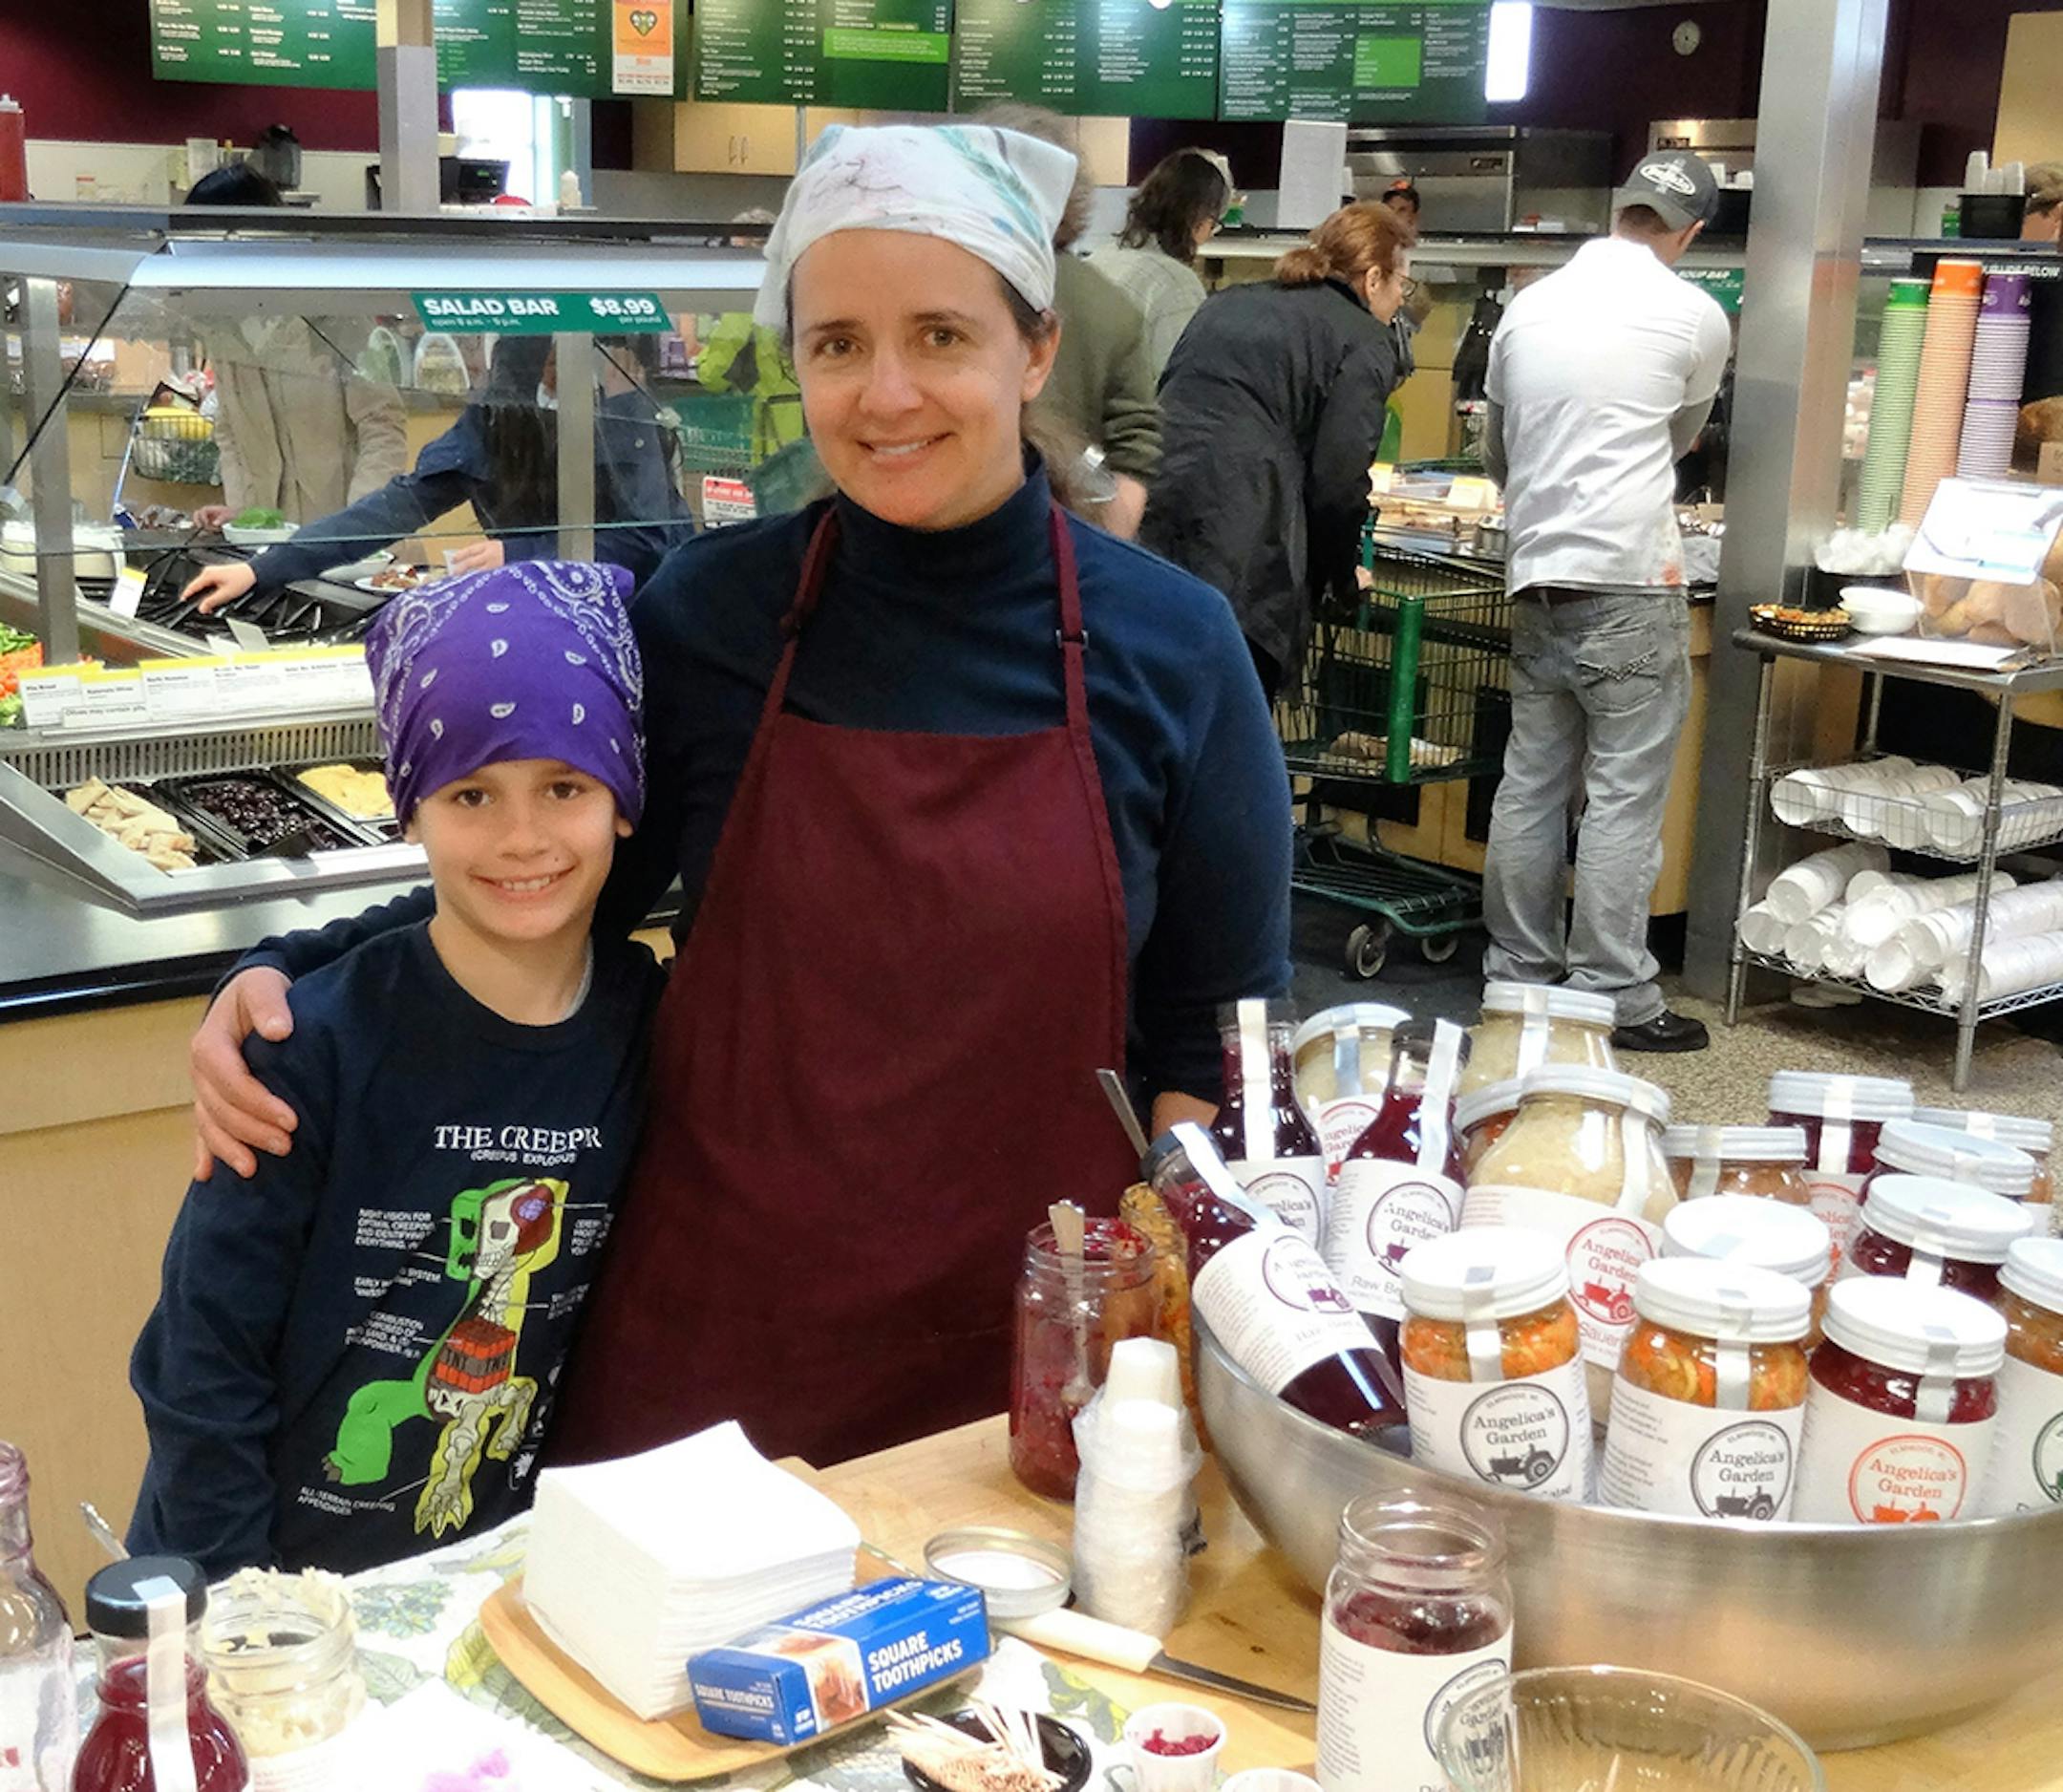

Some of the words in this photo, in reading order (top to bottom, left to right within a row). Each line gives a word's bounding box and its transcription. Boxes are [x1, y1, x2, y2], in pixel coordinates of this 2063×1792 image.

[423, 297, 505, 316] SALAD
[506, 298, 561, 316] BAR
[589, 297, 657, 318] $8.99
[434, 1124, 494, 1150] THE
[1473, 1405, 1556, 1431] Angelica's
[1484, 1426, 1547, 1446] Garden
[1708, 1448, 1785, 1468] Angelica's
[1868, 1457, 1958, 1483] Angelica's
[1718, 1466, 1776, 1483] Garden
[1877, 1476, 1943, 1500] Garden
[867, 1630, 930, 1672] SQUARE
[870, 1639, 964, 1695] TOOTHPICKS
